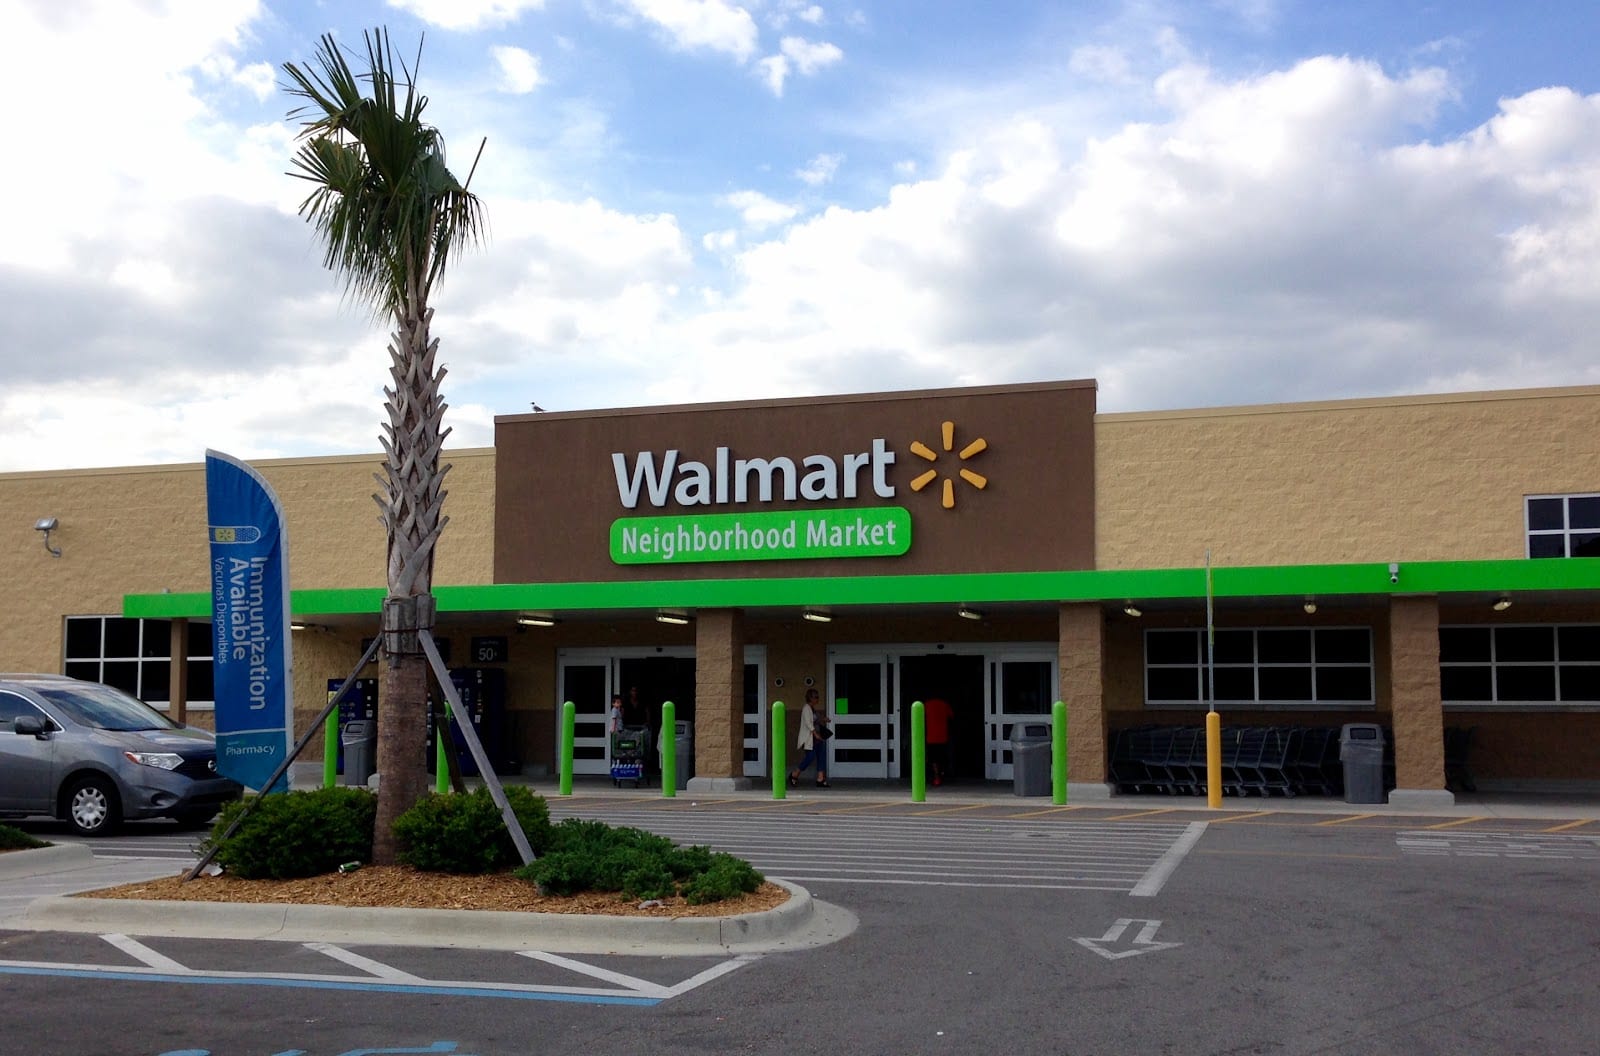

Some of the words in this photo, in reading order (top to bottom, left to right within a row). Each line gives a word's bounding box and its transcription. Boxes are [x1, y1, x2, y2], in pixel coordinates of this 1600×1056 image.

[611, 438, 896, 508] Walmart
[621, 519, 797, 560] Neighborhood
[805, 517, 897, 549] Market
[214, 556, 225, 601] Vacunas
[229, 556, 251, 660] Available
[215, 602, 229, 664] Disponibles
[249, 556, 271, 711] Immunization
[225, 745, 276, 756] Pharmacy
